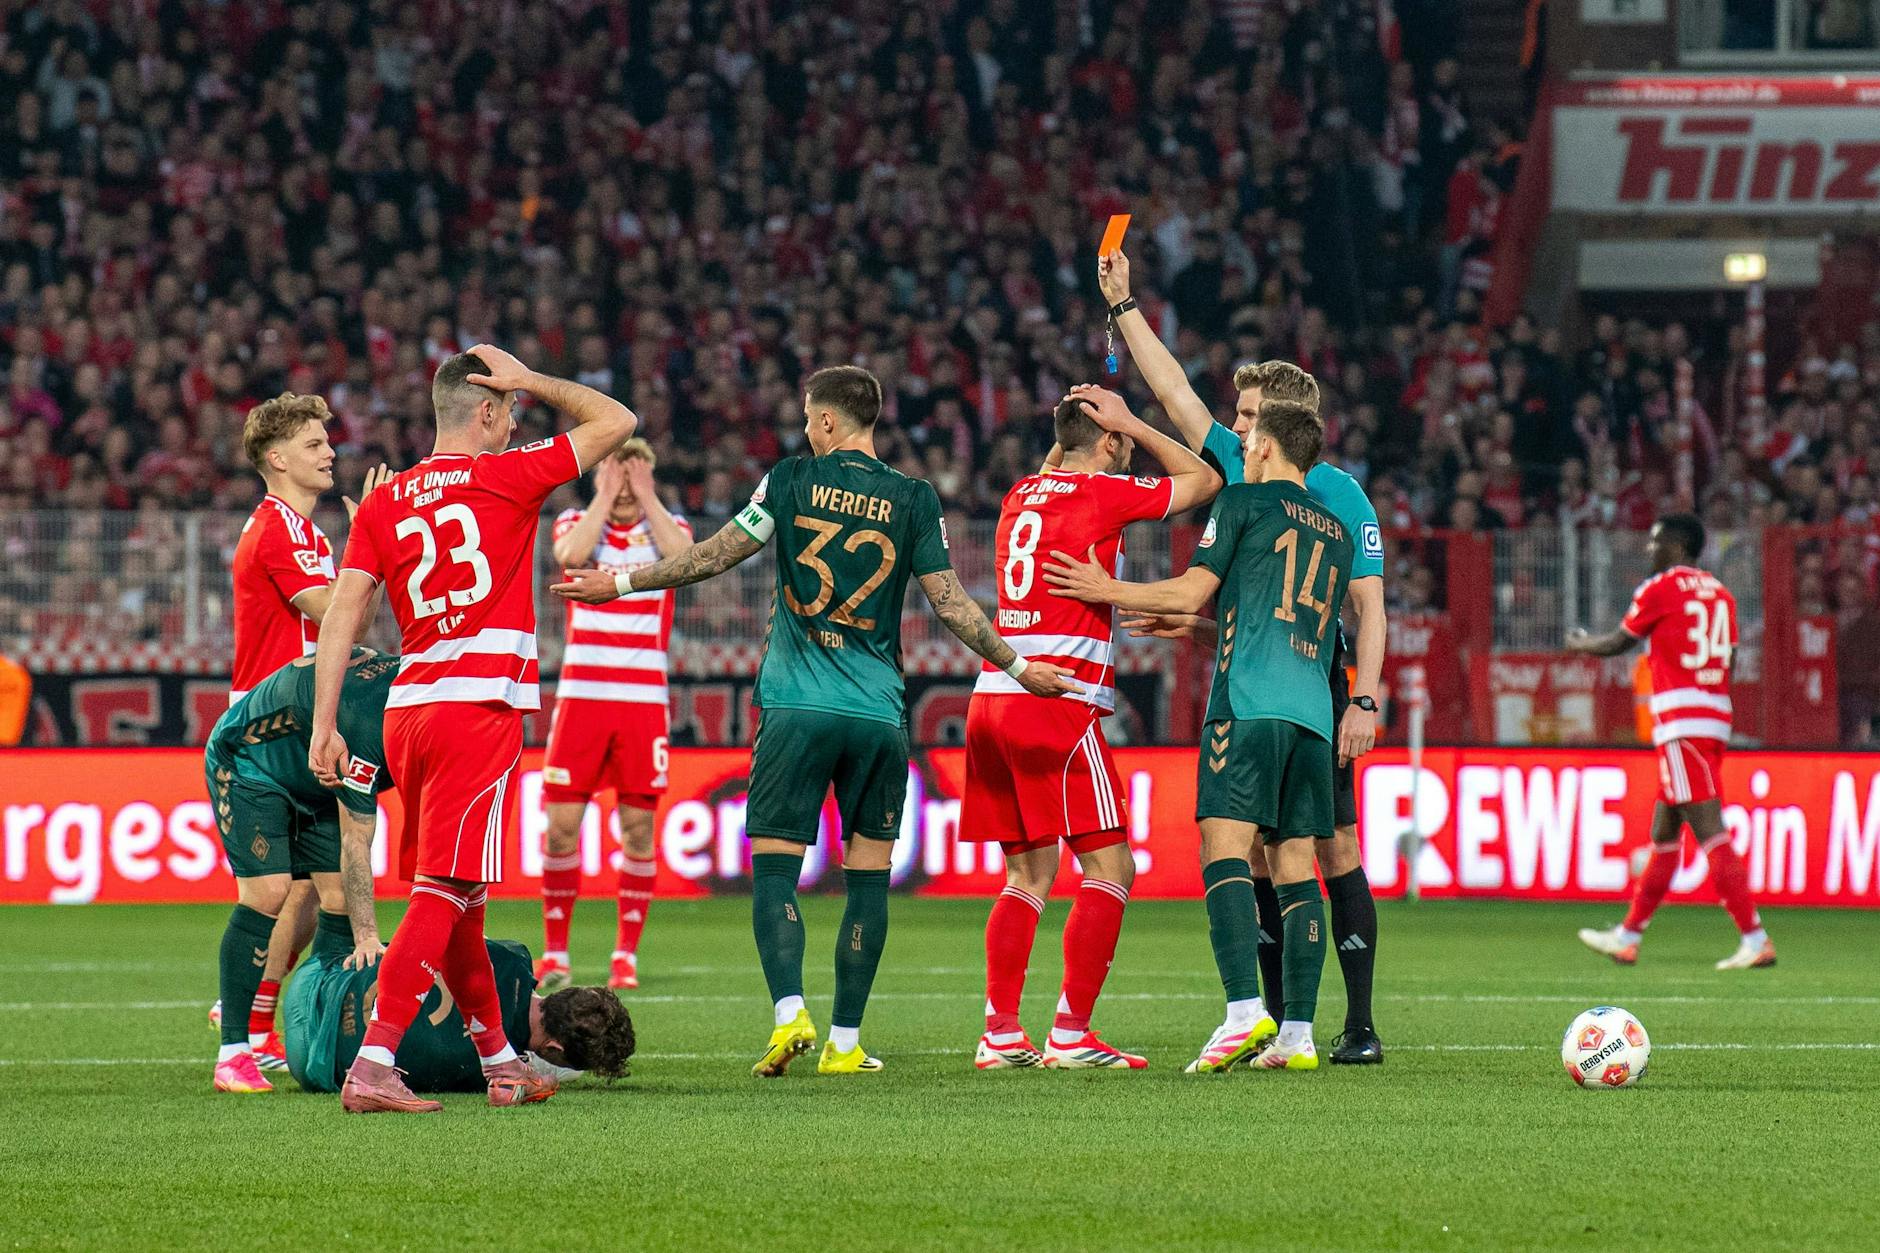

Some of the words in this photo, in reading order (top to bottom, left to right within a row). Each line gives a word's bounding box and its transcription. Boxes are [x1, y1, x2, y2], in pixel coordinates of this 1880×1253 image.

[405, 477, 421, 497] FC
[423, 468, 472, 490] UNION
[413, 488, 443, 508] BERLIN
[811, 484, 893, 524] WERDER
[1280, 498, 1344, 543] WERDER
[395, 503, 493, 620] 23
[784, 515, 897, 631] 32
[1004, 510, 1043, 601] 8
[1274, 528, 1338, 640] 14
[1680, 599, 1732, 669] 34
[652, 737, 669, 772] 6
[1363, 764, 1629, 891] REWE
[1580, 1038, 1625, 1072] DERBYSTAR
